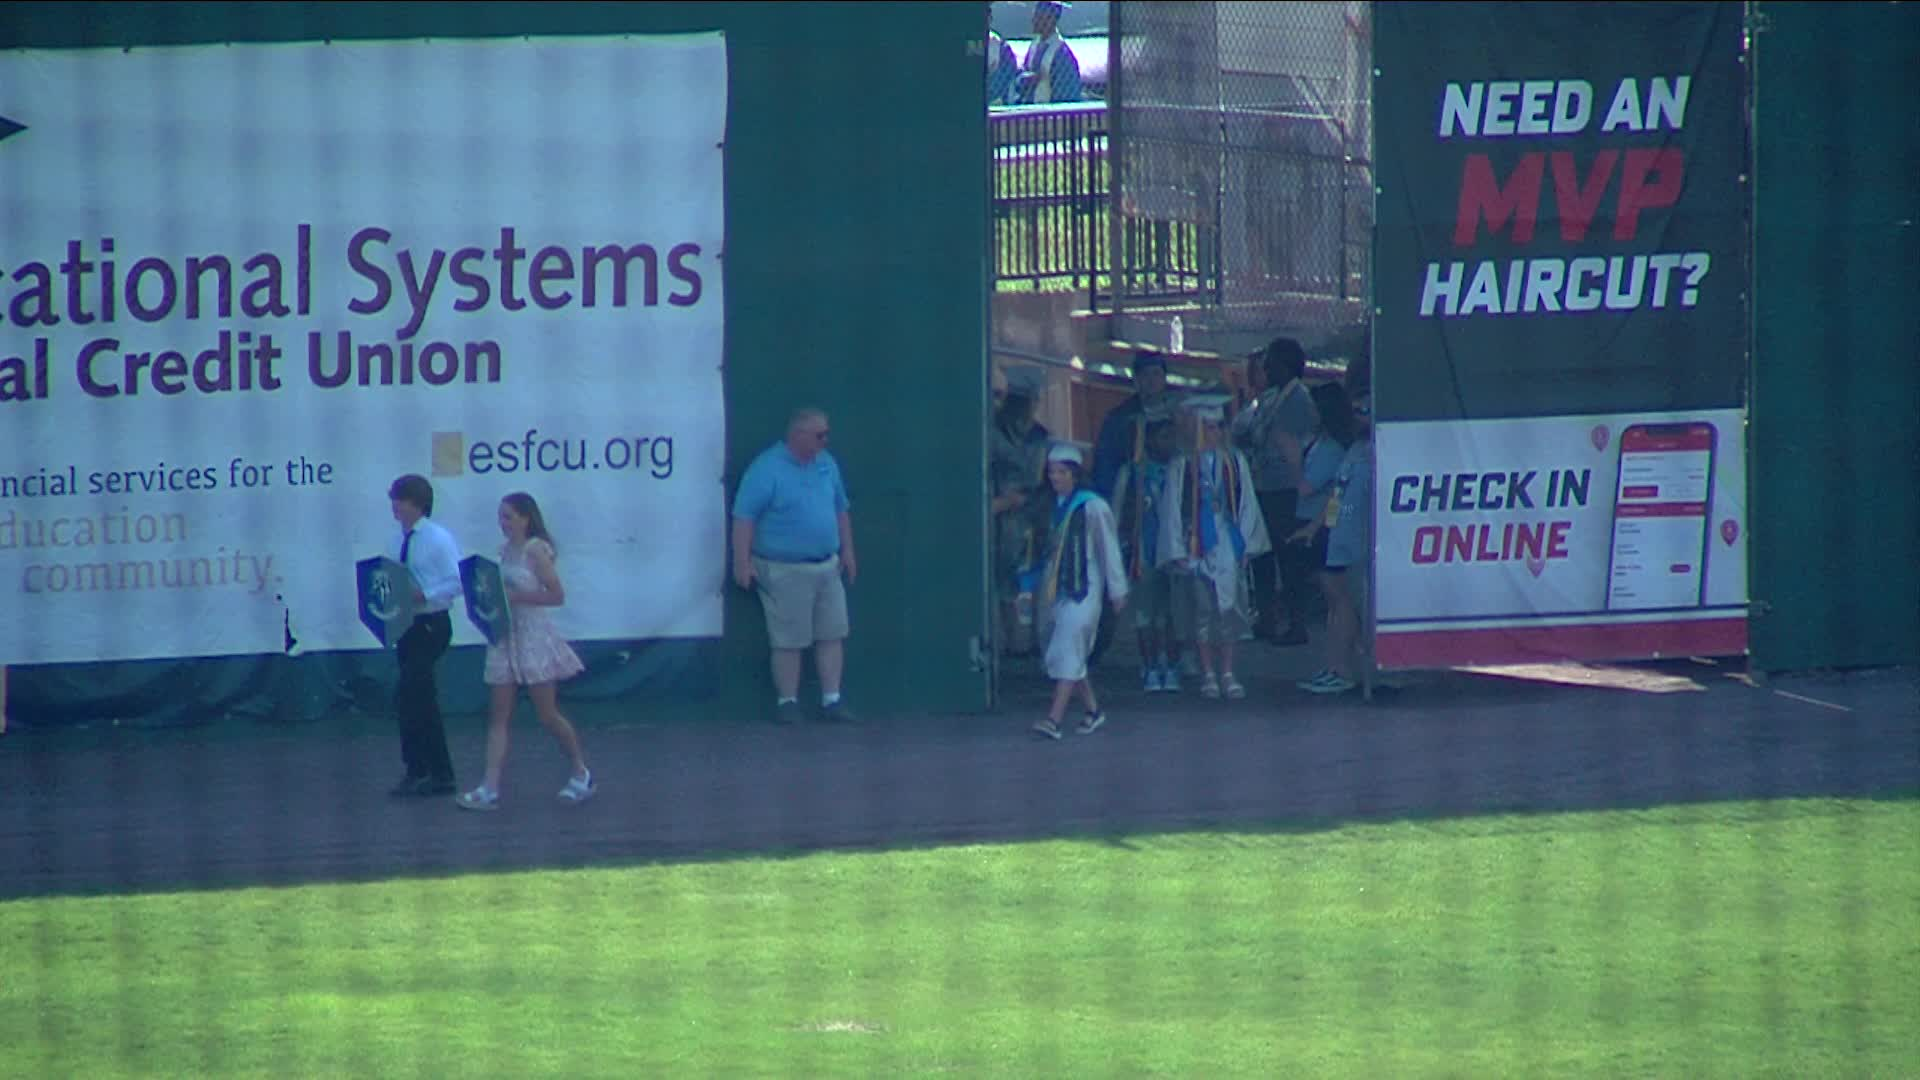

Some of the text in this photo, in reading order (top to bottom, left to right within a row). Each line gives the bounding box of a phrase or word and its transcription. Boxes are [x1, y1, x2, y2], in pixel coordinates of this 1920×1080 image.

[1439, 75, 1692, 137] NEED AN
[1453, 147, 1685, 246] MVP
[0, 223, 703, 341] ational Systems
[1419, 252, 1711, 317] HAIRCUT?
[76, 330, 282, 399] Credit
[308, 330, 502, 389] Union
[89, 462, 217, 494] services
[229, 457, 274, 488] for
[286, 455, 334, 486] the
[468, 429, 674, 480] esfcu.org
[1390, 470, 1538, 513] CHECK
[1545, 468, 1592, 508] IN
[1411, 520, 1573, 564] ONLINE
[22, 545, 284, 597] community.
